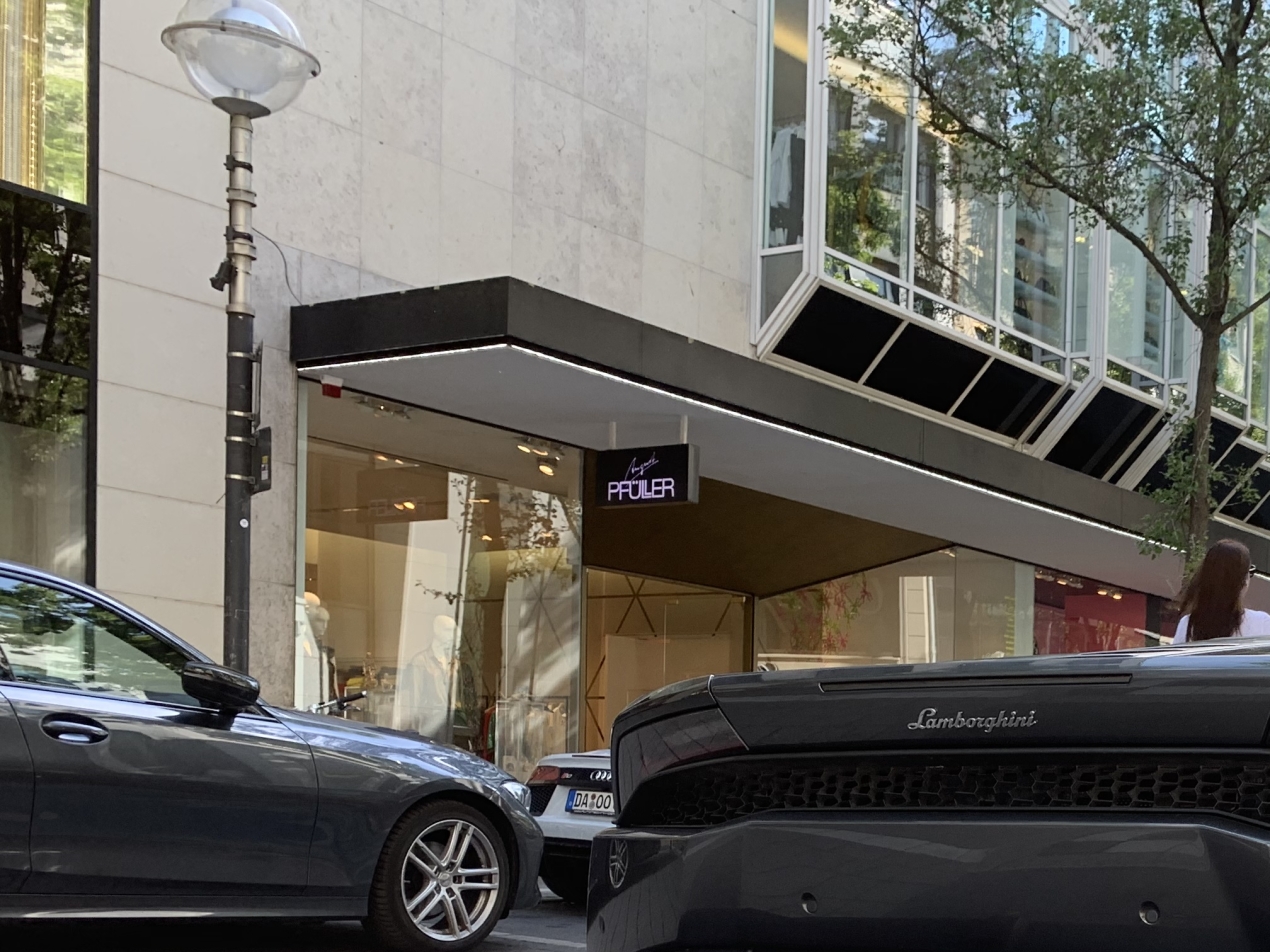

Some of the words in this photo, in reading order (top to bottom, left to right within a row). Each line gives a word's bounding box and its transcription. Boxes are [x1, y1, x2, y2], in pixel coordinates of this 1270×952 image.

[607, 477, 675, 501] PFÜLLER
[907, 707, 1039, 733] Lamborghini
[574, 793, 588, 808] DA
